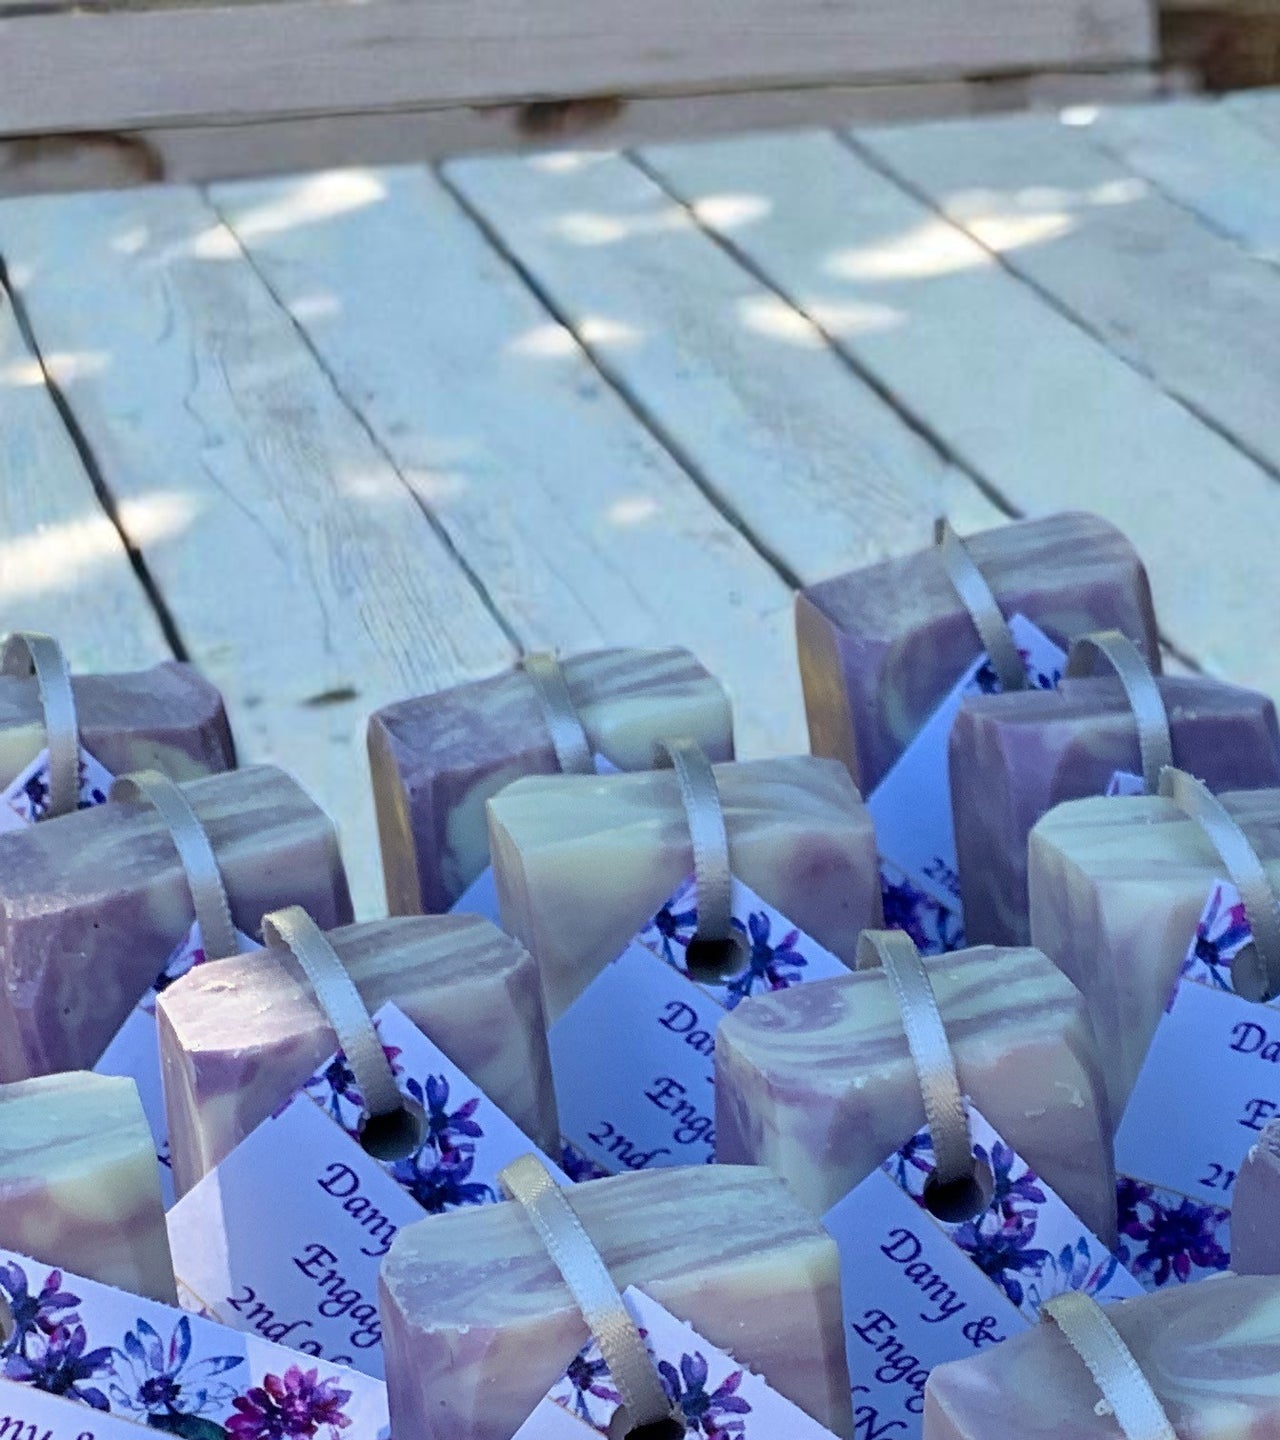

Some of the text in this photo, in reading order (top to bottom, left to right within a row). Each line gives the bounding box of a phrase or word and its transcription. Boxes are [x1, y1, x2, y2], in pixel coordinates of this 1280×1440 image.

[588, 1121, 671, 1169] 2nd
[226, 1286, 310, 1345] 2nd
[880, 1228, 1006, 1348] Dany &
